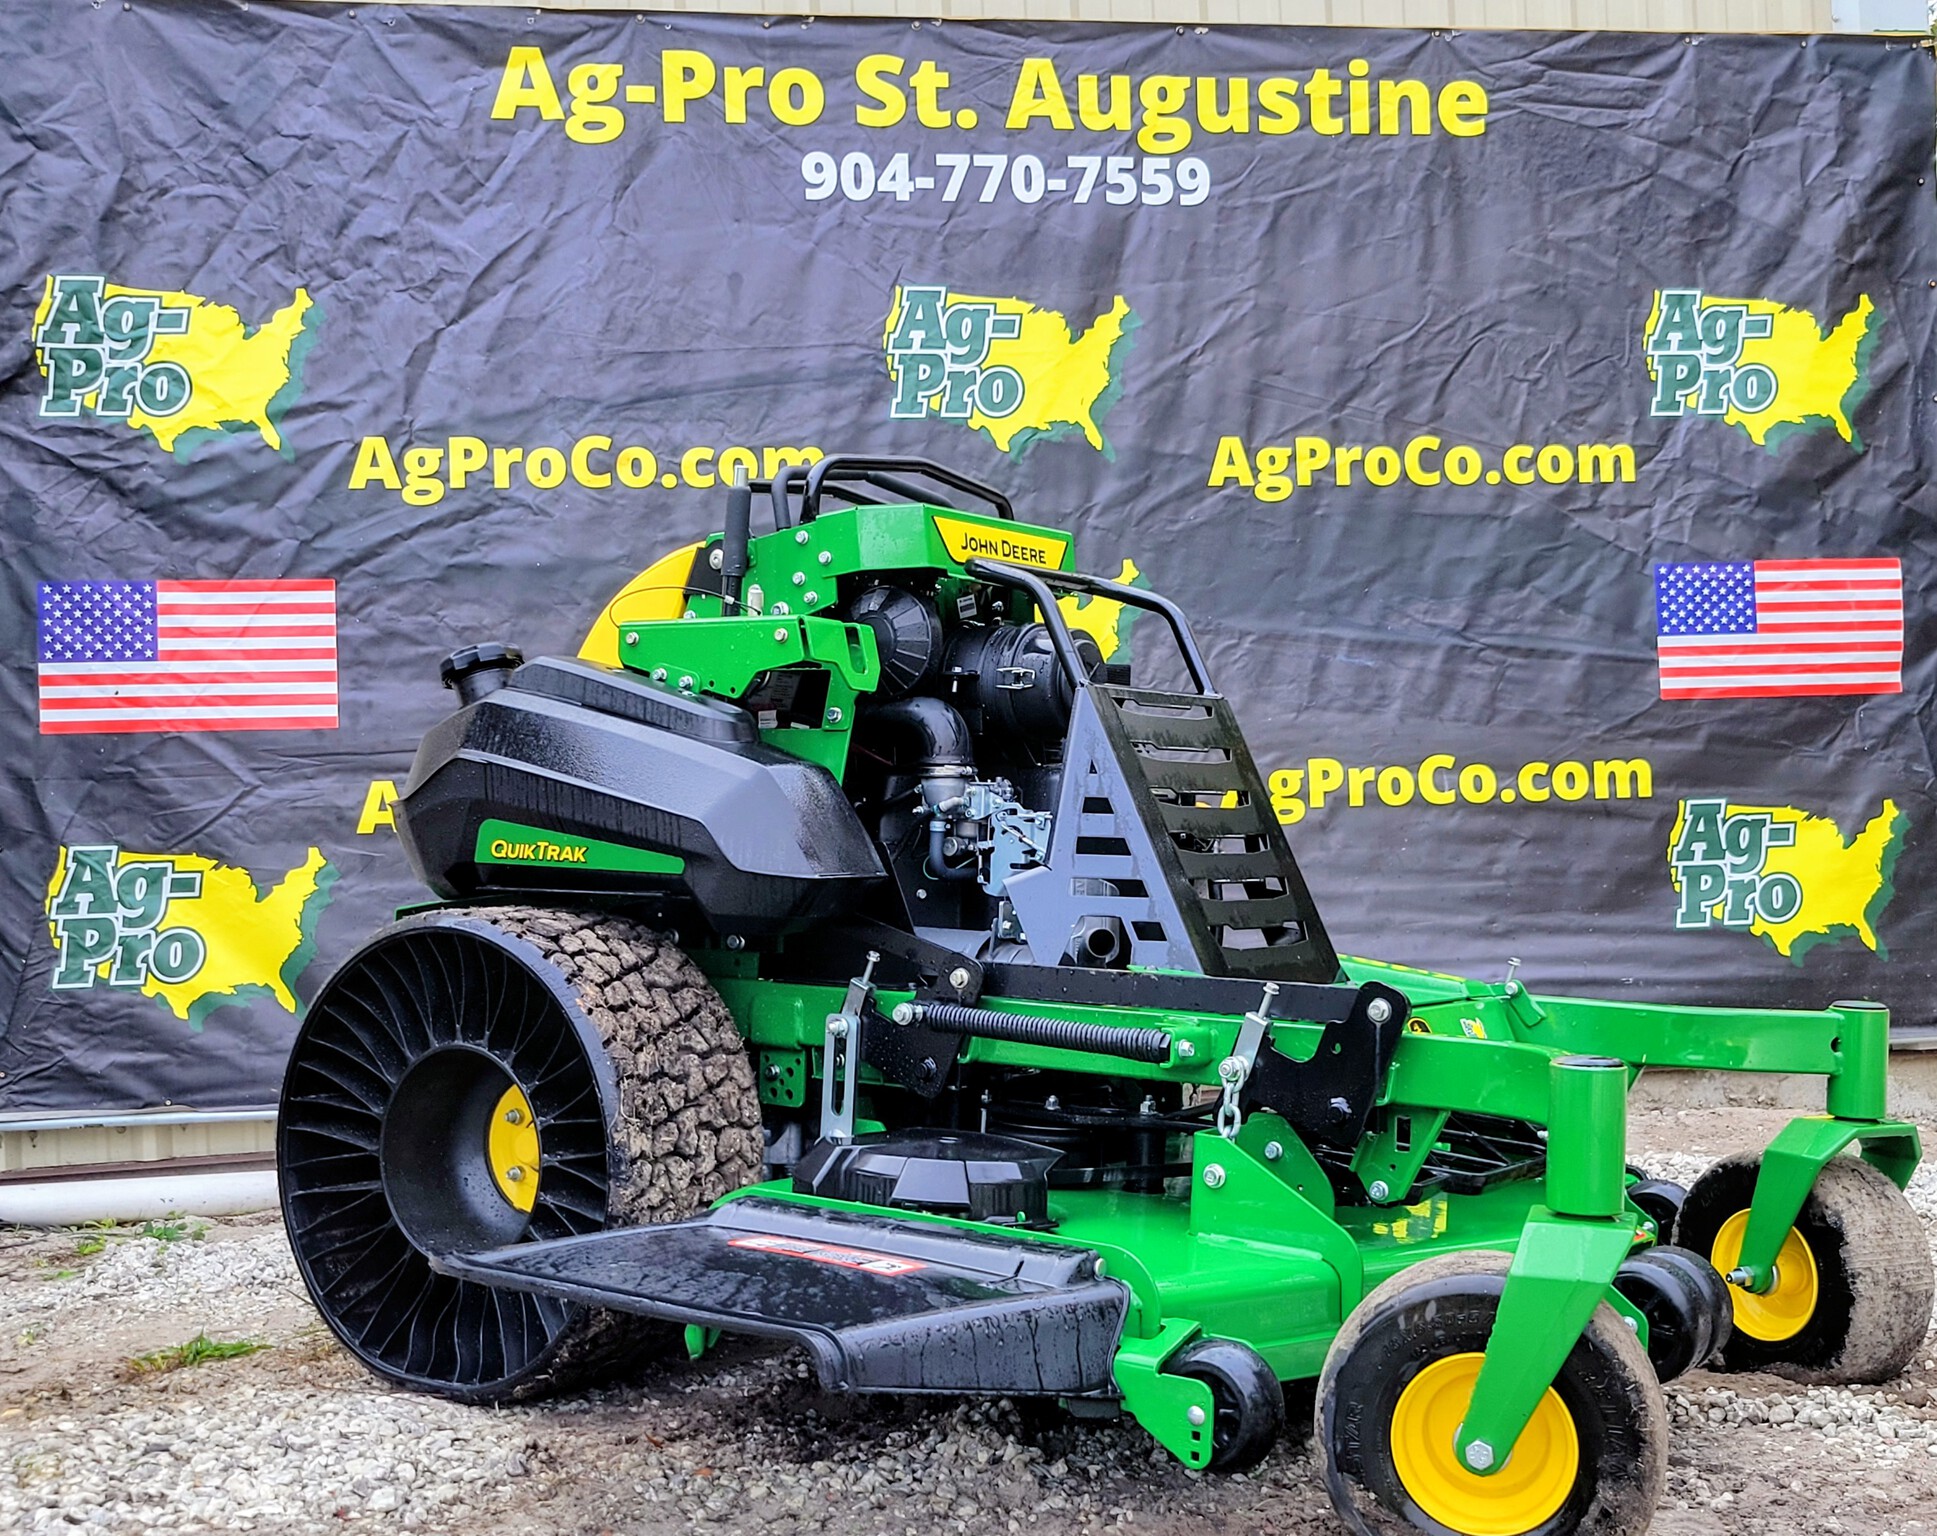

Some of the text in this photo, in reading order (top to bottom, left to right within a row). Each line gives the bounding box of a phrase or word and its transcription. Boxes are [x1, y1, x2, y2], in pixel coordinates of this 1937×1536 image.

[491, 46, 1489, 156] Ag-Pro St. Augustine
[801, 151, 1211, 206] 904-770-7559
[37, 275, 189, 362] Ag-
[888, 286, 1021, 367] Ag-
[1647, 290, 1772, 367] Ag-
[39, 347, 192, 417] Pro
[890, 353, 1024, 418] Pro
[1651, 353, 1778, 417] Pro
[1208, 436, 1637, 503] AgProCo.com
[1221, 752, 1654, 826] gProCo.com
[1671, 799, 1796, 876] Ag-
[51, 845, 202, 931] Ag-
[1675, 864, 1803, 928] Pro
[52, 917, 206, 989] Pro
